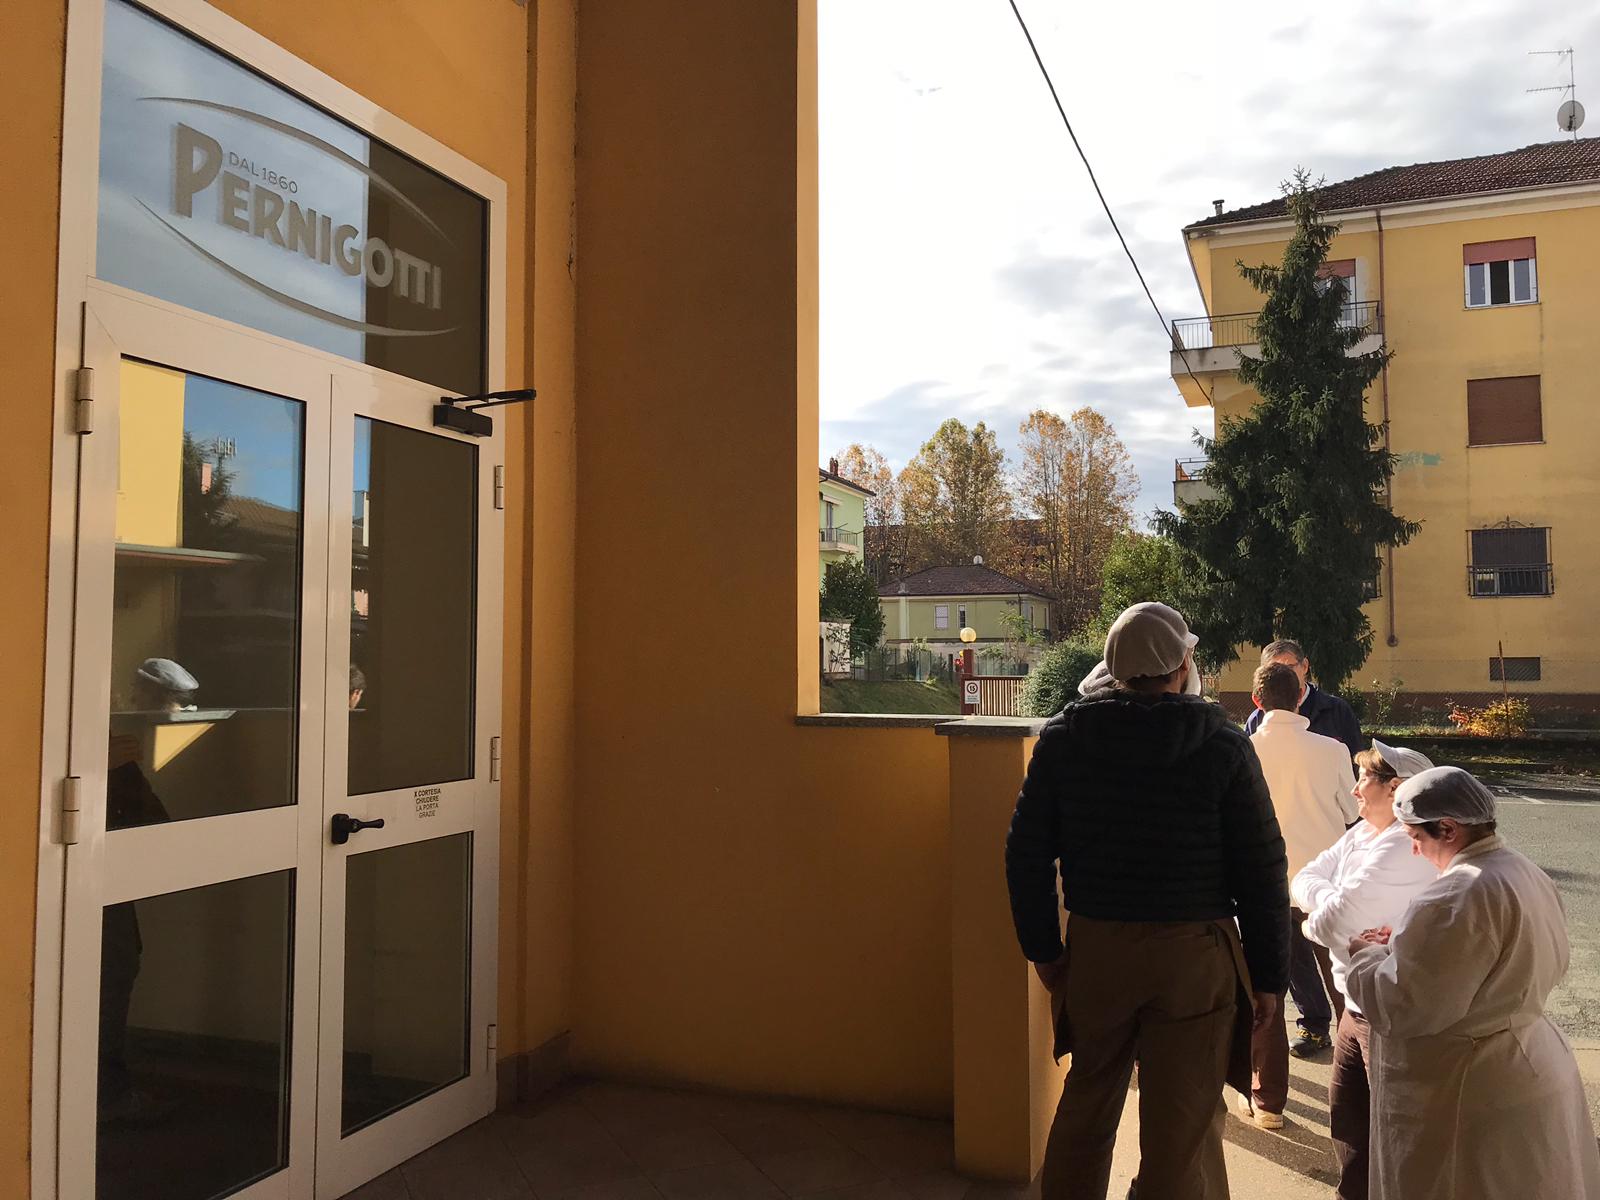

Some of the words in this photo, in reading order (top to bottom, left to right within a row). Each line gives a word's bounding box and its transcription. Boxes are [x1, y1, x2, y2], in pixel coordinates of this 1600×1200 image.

[229, 151, 260, 178] DAL
[261, 167, 298, 194] 1860
[174, 122, 442, 310] PERNIGOTTI
[418, 788, 441, 796] CORTESIA
[416, 795, 439, 804] CHIUDERE
[419, 810, 435, 818] GRAZIE
